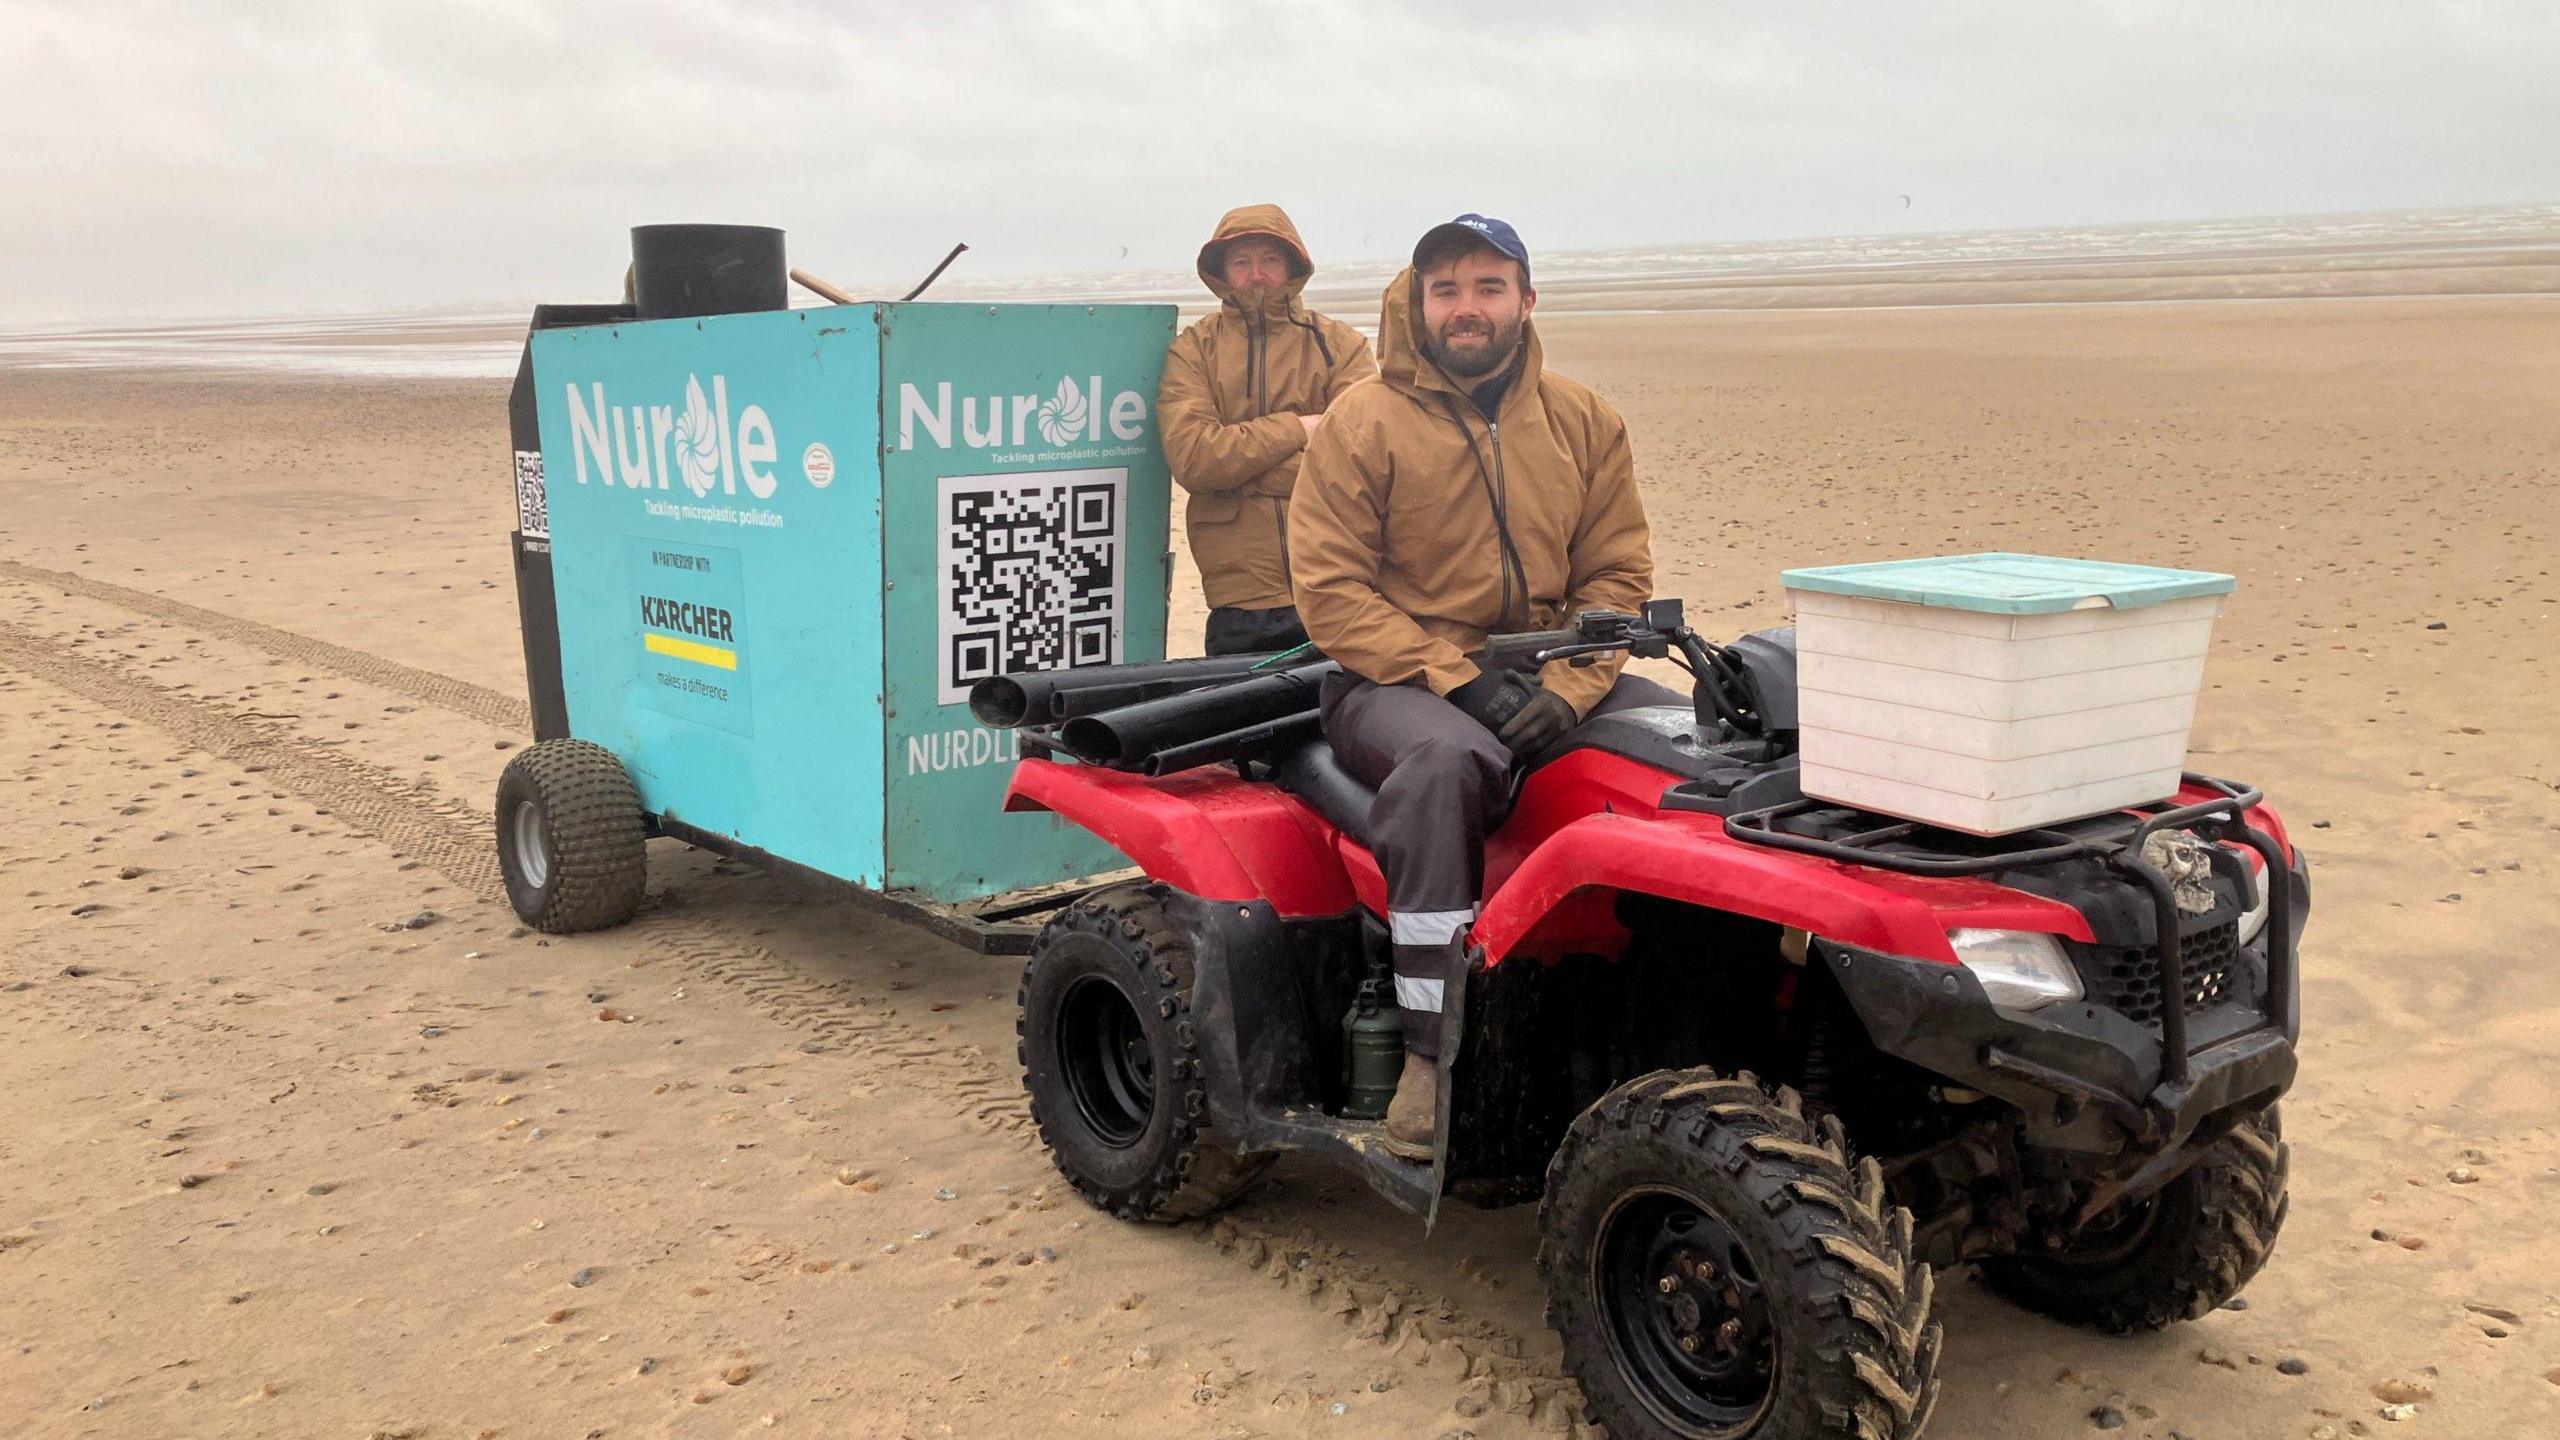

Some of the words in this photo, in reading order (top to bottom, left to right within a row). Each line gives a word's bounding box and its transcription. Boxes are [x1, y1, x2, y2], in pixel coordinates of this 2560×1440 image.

[900, 375, 1147, 451] Nurdle
[566, 372, 777, 499] Nurdle
[991, 453, 1035, 464] Tackling
[1038, 448, 1099, 461] microplastic
[1102, 446, 1146, 458] pollution
[644, 499, 680, 521] Tackling
[682, 503, 737, 523] microplastic
[739, 508, 783, 528] pollution
[652, 551, 658, 565] IN
[659, 552, 694, 570] PARTNERSHIP
[695, 557, 711, 573] WITH
[640, 594, 734, 642] KÄRCHER
[657, 672, 681, 689] makes
[682, 679, 687, 691] a
[688, 678, 729, 702] difference
